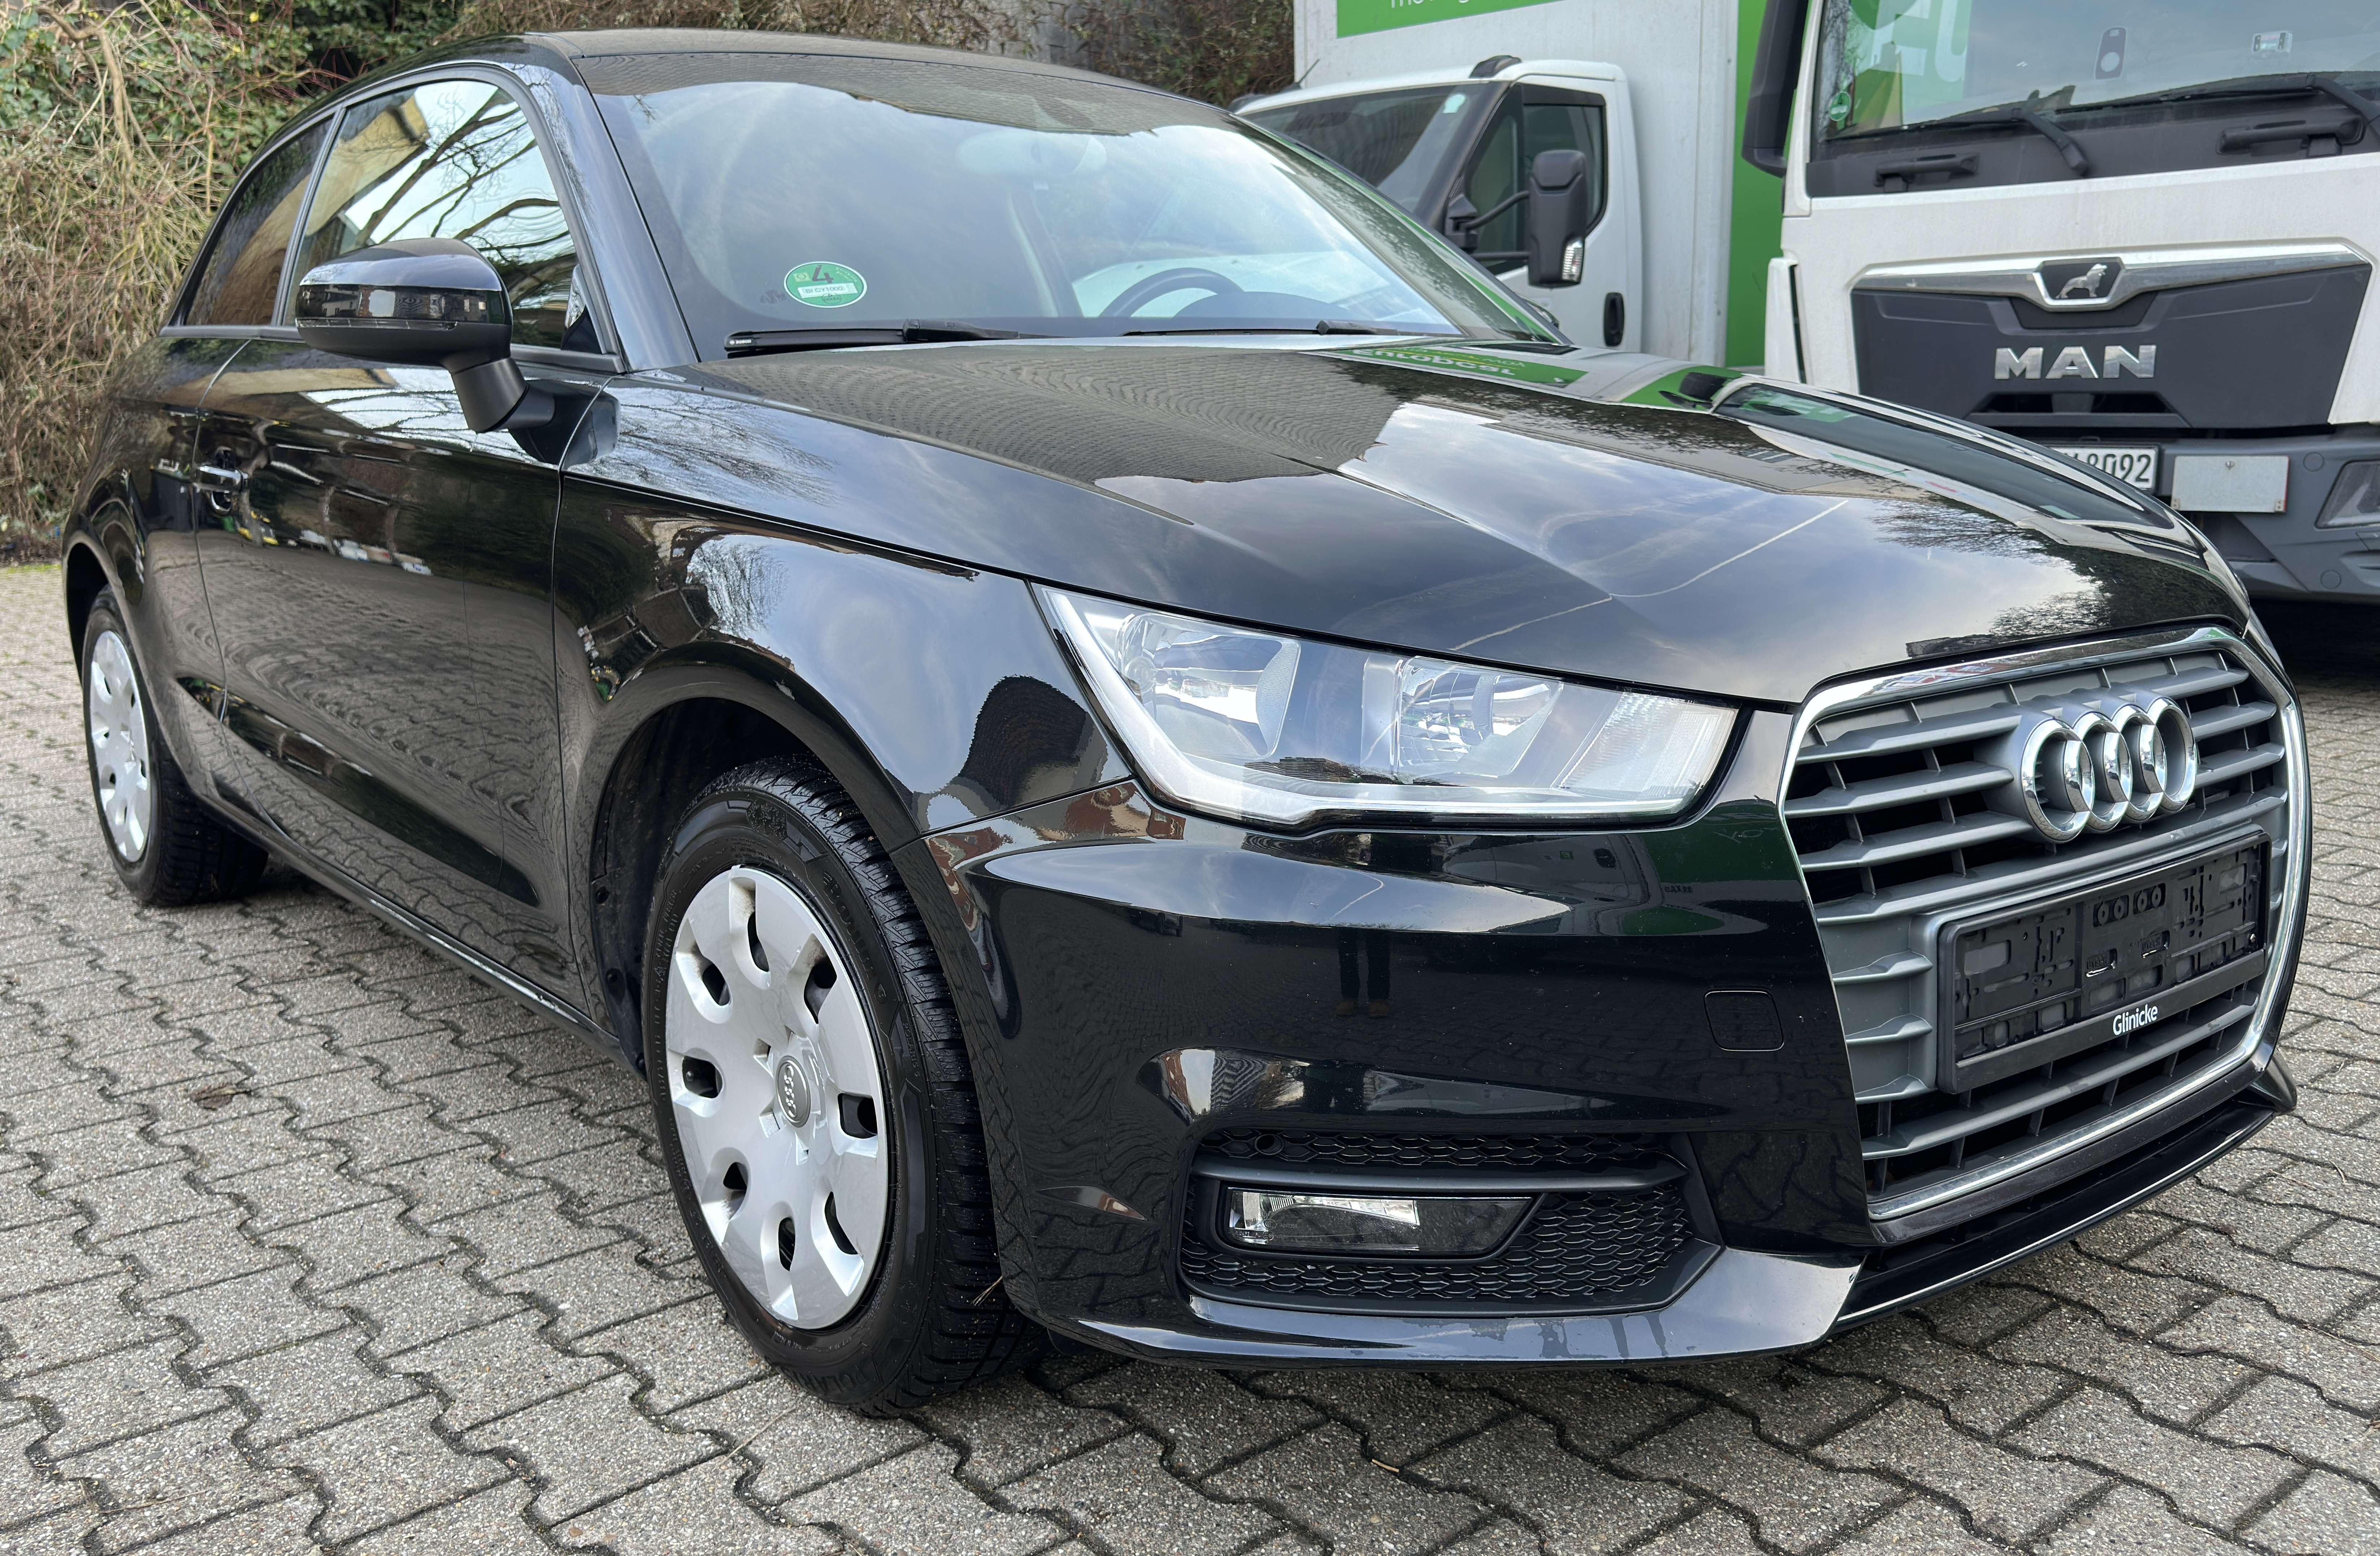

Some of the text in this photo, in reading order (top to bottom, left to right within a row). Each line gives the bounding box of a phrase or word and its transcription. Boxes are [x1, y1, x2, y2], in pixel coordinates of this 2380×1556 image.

[812, 265, 834, 284] 4
[1995, 345, 2156, 379] MAN
[2113, 1004, 2157, 1035] Glinicke
